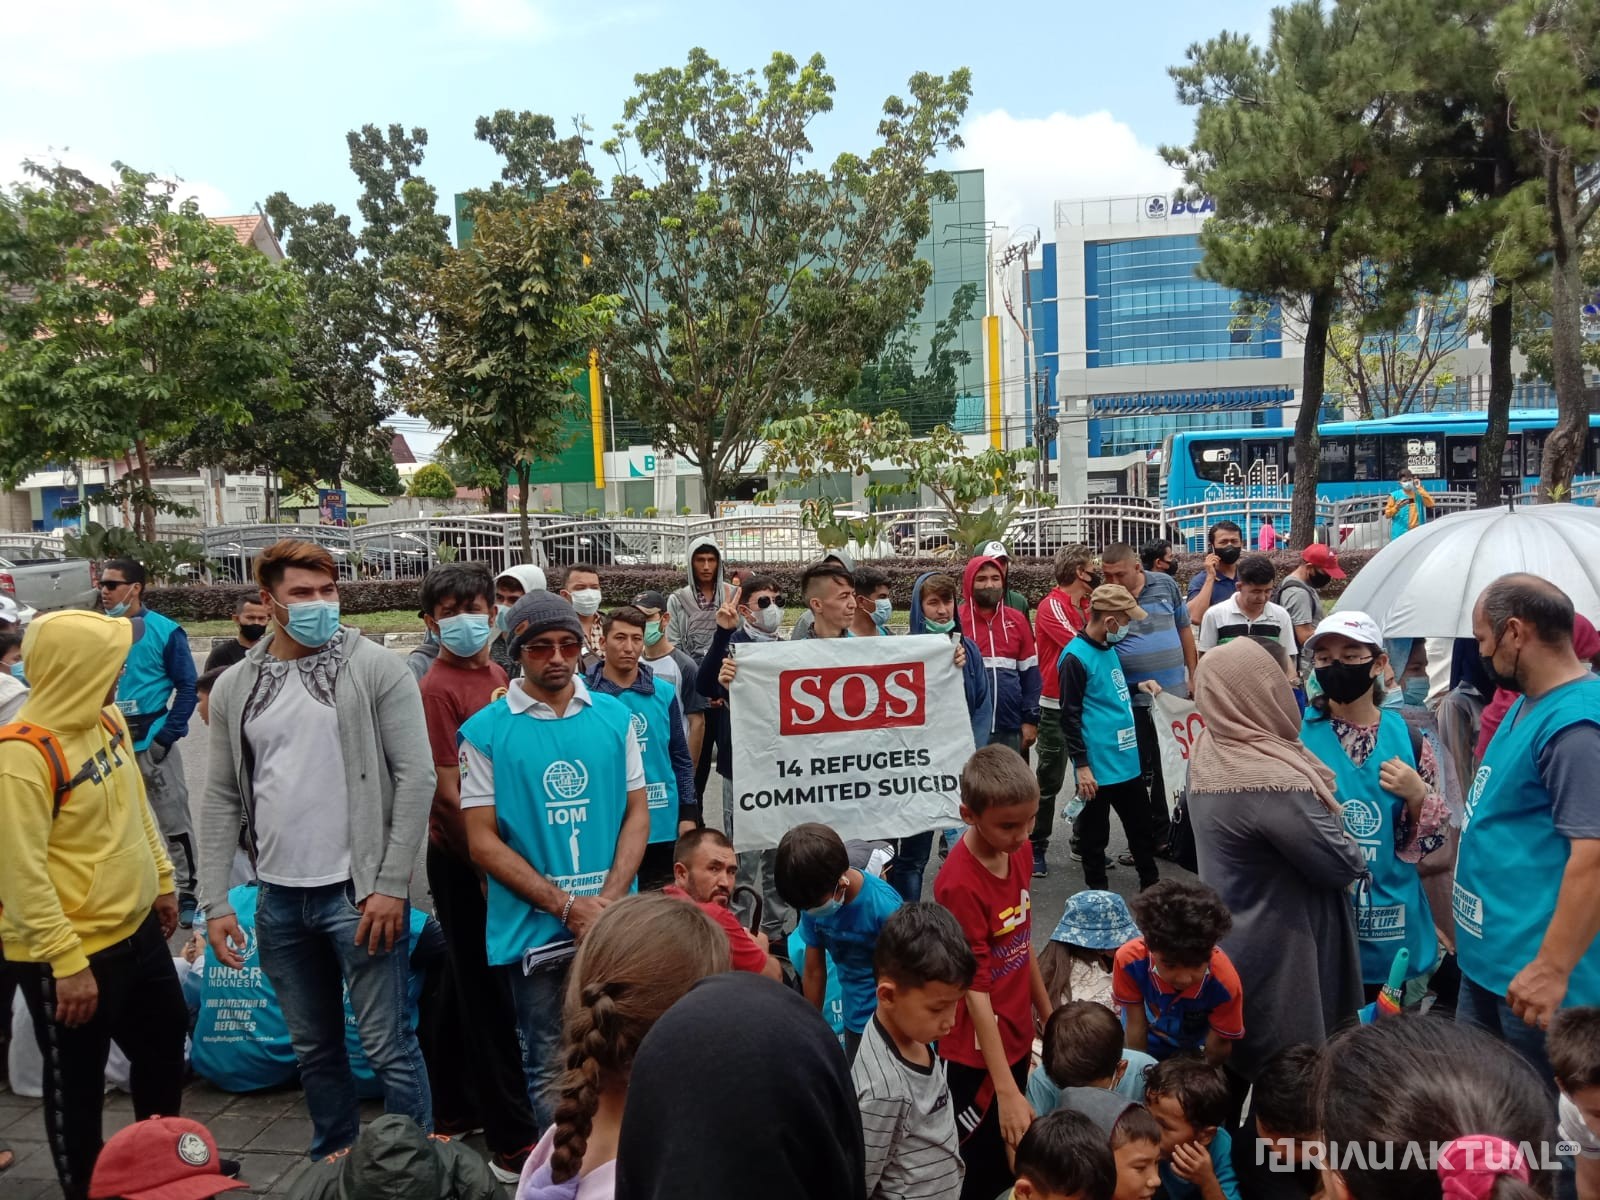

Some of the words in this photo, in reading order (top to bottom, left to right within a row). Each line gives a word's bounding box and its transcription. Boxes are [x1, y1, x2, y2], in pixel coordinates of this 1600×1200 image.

[1171, 197, 1216, 215] BCA
[789, 668, 919, 726] SOS
[776, 759, 803, 778] 14
[810, 748, 931, 776] REFUGEES
[739, 781, 872, 812] COMMITED
[878, 773, 963, 797] SUICID
[547, 806, 587, 825] IOM
[571, 875, 603, 888] CRIMES
[1378, 916, 1399, 927] LIFE
[208, 967, 262, 979] UNHCR
[208, 979, 262, 988] INDONESIA
